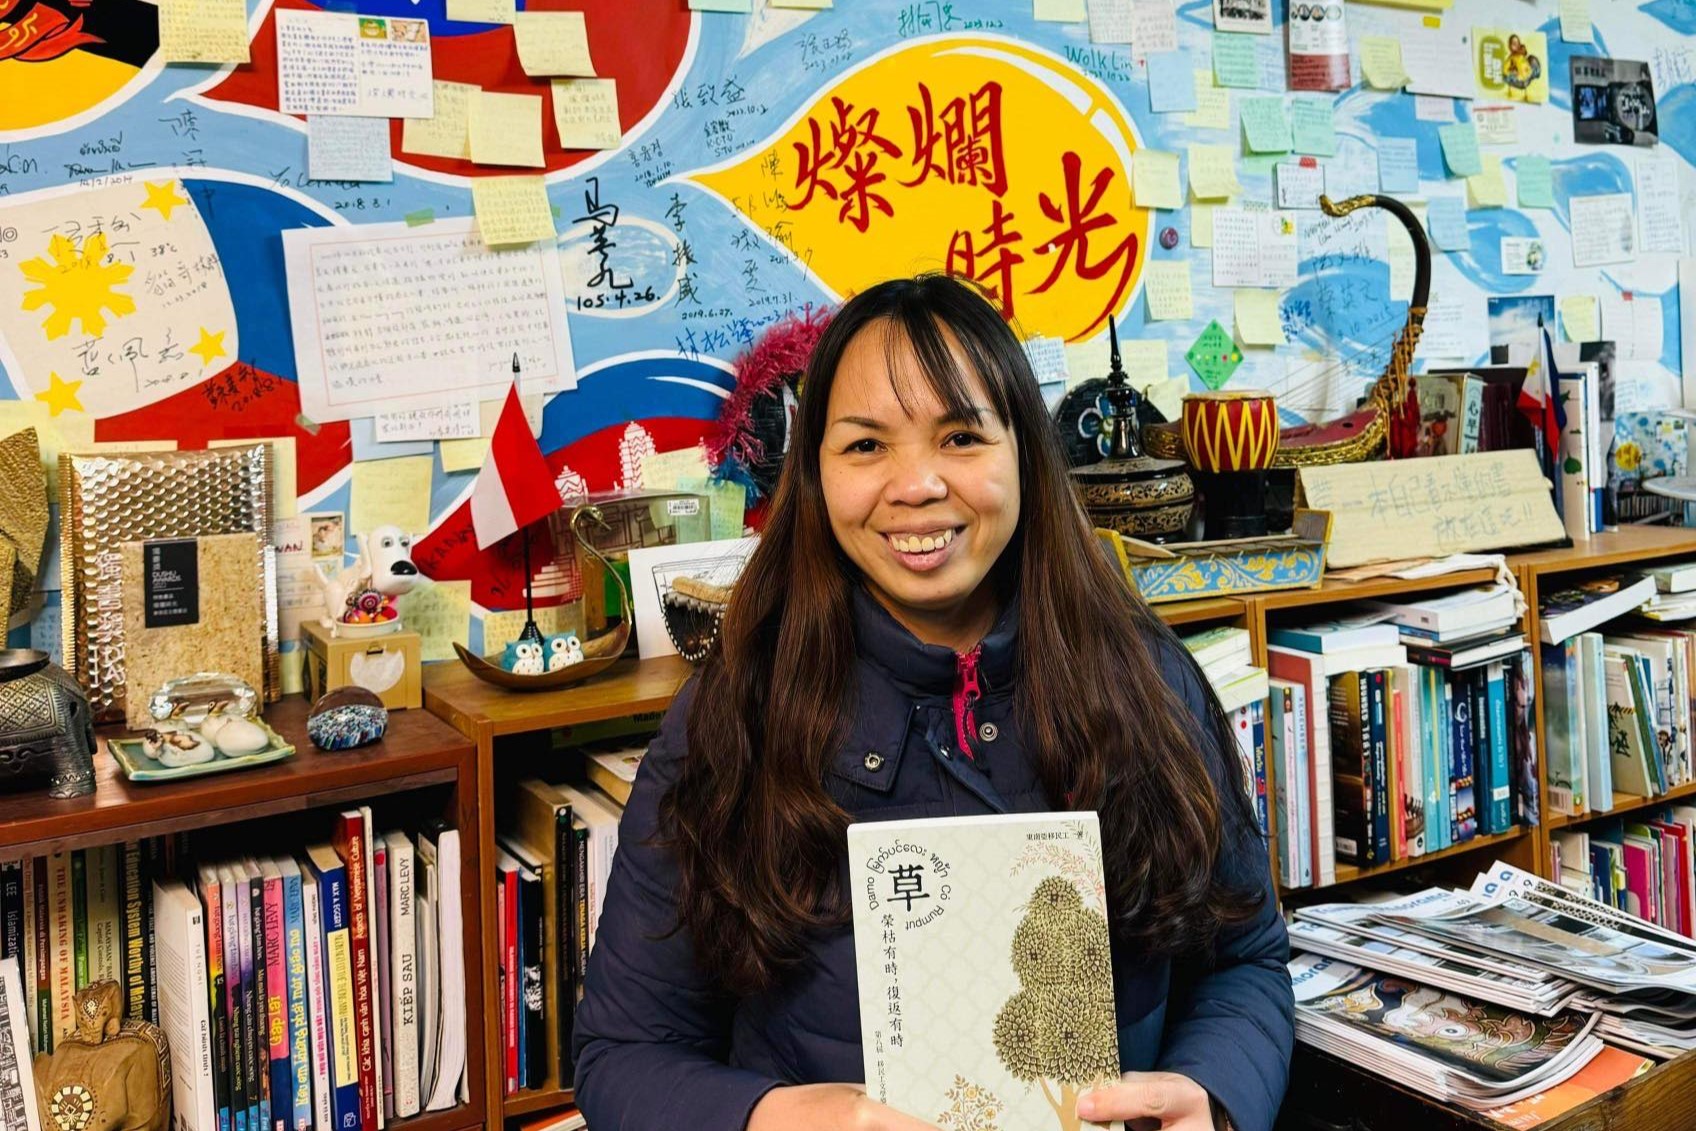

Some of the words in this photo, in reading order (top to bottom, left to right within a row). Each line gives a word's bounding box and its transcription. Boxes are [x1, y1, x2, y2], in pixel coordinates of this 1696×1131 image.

[571, 176, 635, 290] 馬英九
[350, 836, 361, 860] Culture
[56, 866, 67, 889] THE
[126, 852, 141, 900] Education
[351, 861, 362, 901] Vietnamese
[399, 857, 410, 885] LEVY
[7, 881, 18, 897] LEE
[400, 885, 411, 916] MARC
[577, 883, 586, 898] ERA
[866, 876, 880, 911] Damo
[886, 863, 930, 912] 草
[57, 891, 69, 946] UNMAKING
[126, 901, 143, 938] System
[265, 902, 279, 931] LEVY
[333, 904, 342, 928] EGGERT
[353, 913, 365, 939] Aspects
[578, 899, 587, 926] TENAGA
[905, 904, 945, 931] Rumput
[266, 931, 281, 967] MARC
[579, 927, 587, 950] KERJA
[58, 949, 68, 963] OF
[127, 938, 144, 975] Worthy
[356, 949, 366, 967] Nam
[402, 953, 413, 982] SAU
[130, 976, 144, 987] of
[356, 969, 368, 983] Việt
[58, 966, 70, 1020] MALAYSIA
[130, 987, 146, 1020] Malays
[399, 987, 414, 1026] KIẾP
